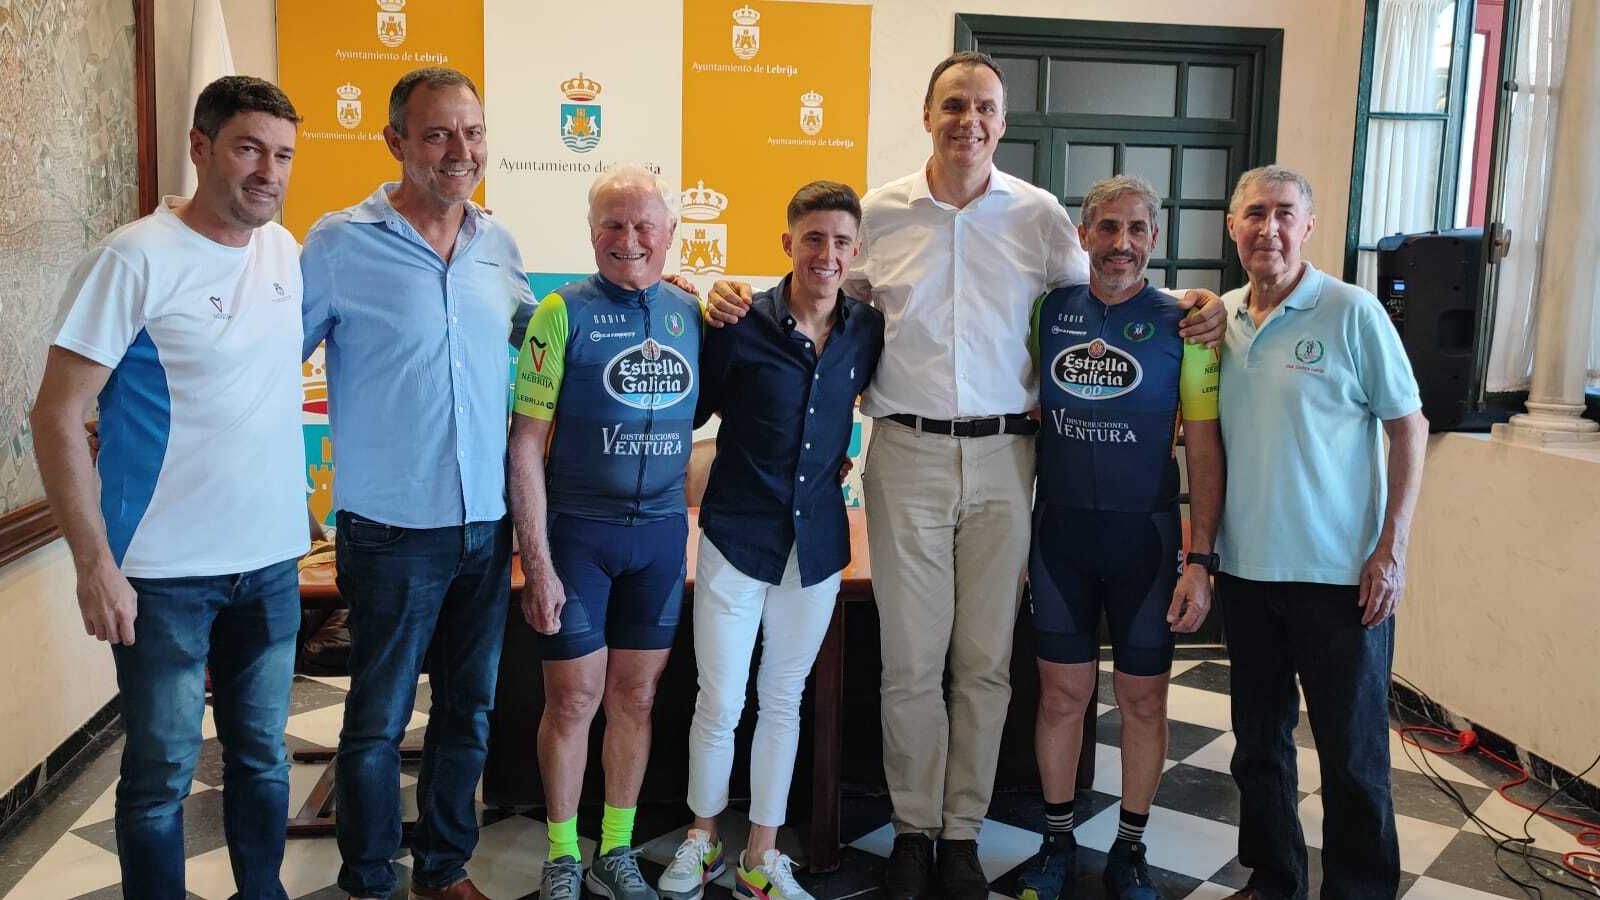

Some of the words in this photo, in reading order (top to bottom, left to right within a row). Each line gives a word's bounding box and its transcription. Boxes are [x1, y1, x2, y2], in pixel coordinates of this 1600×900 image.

[335, 48, 400, 62] Ayuntamiento
[402, 52, 414, 62] de
[415, 53, 448, 65] Lebrija
[692, 61, 752, 73] Ayuntamiento
[754, 63, 765, 72] de
[766, 64, 798, 76] Lebrija
[303, 128, 355, 142] Ayuntamiento
[357, 132, 368, 141] de
[767, 136, 817, 147] Ayuntamiento
[818, 137, 828, 146] de
[828, 138, 854, 149] Lebrija
[499, 158, 591, 175] Ayuntamiento
[595, 160, 608, 173] de
[618, 359, 684, 376] Estrella
[1062, 353, 1128, 372] Estrella
[622, 376, 682, 393] Galicia
[1063, 367, 1125, 386] Galicia
[1051, 408, 1137, 443] VENTURA
[601, 422, 682, 456] VENTURA
